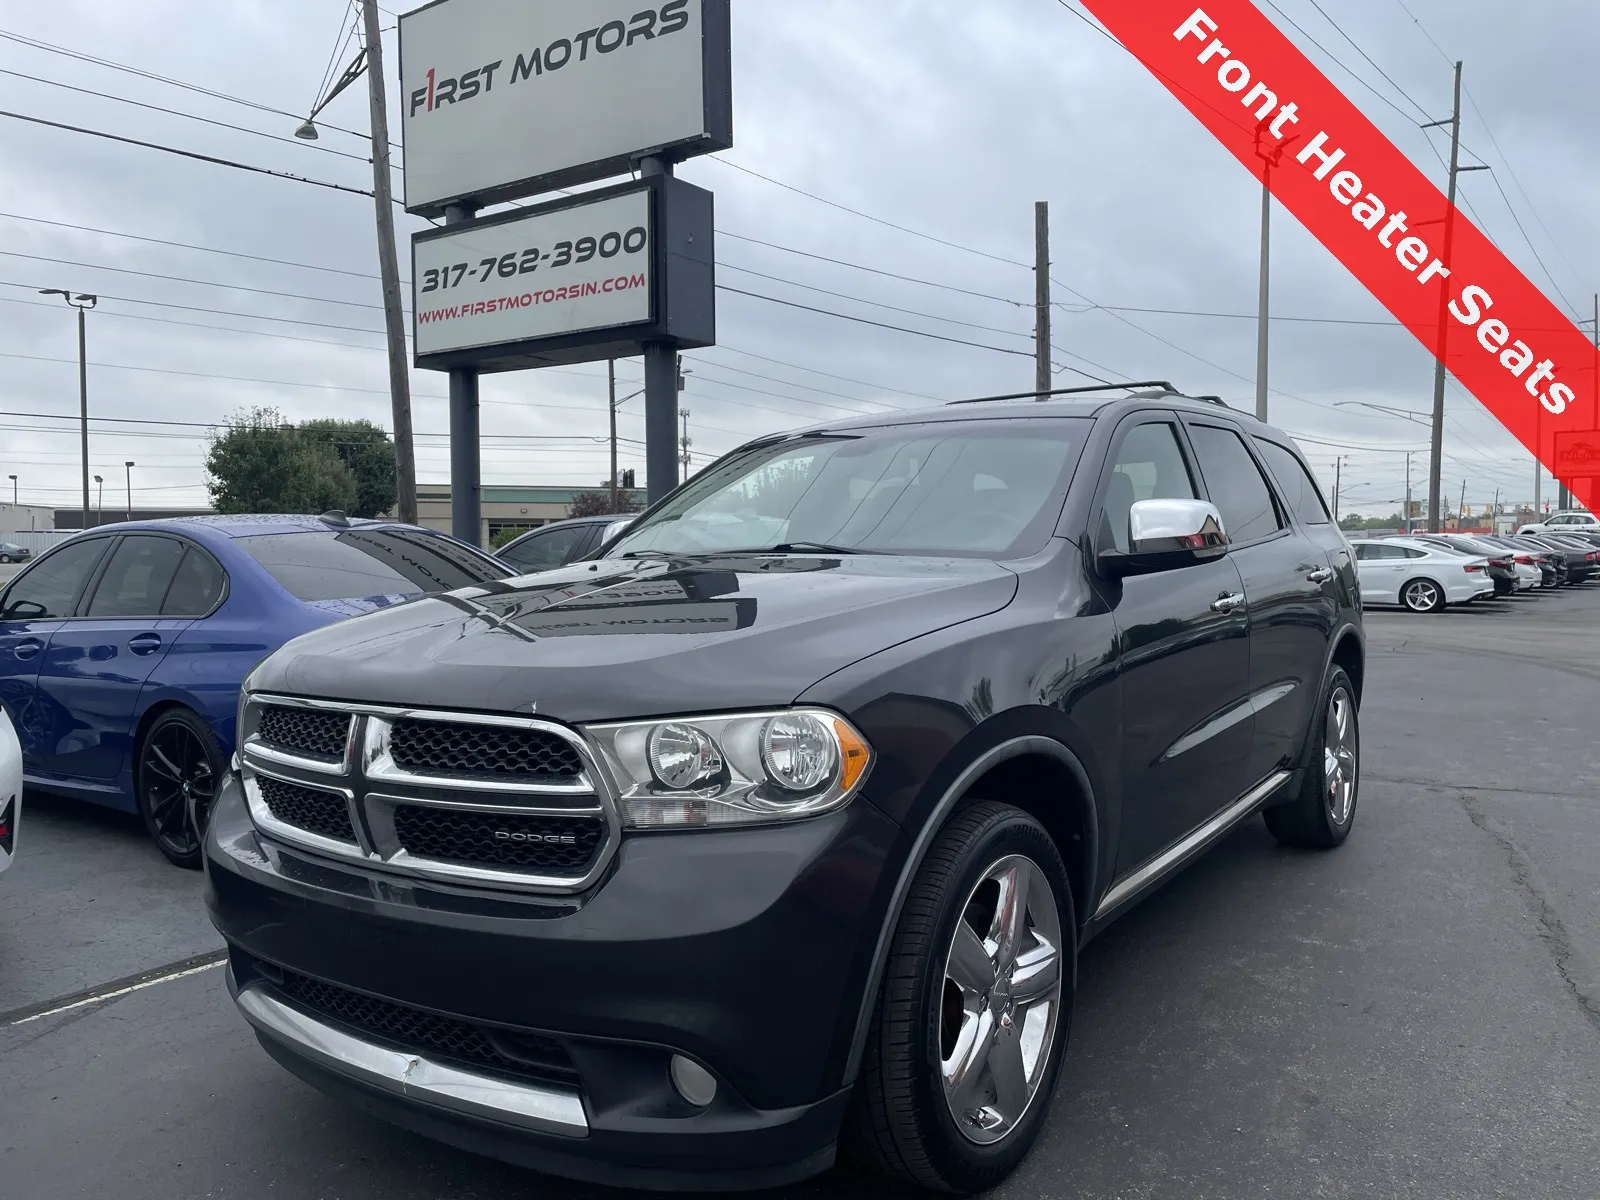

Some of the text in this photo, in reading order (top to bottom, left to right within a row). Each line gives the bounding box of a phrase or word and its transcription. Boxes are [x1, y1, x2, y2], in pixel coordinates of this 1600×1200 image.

[510, 0, 689, 84] MOTORS
[421, 227, 647, 293] 317-762-3900
[418, 273, 646, 325] WWW.FIRSTMOTORSIN.COM
[494, 831, 576, 844] DODGE
